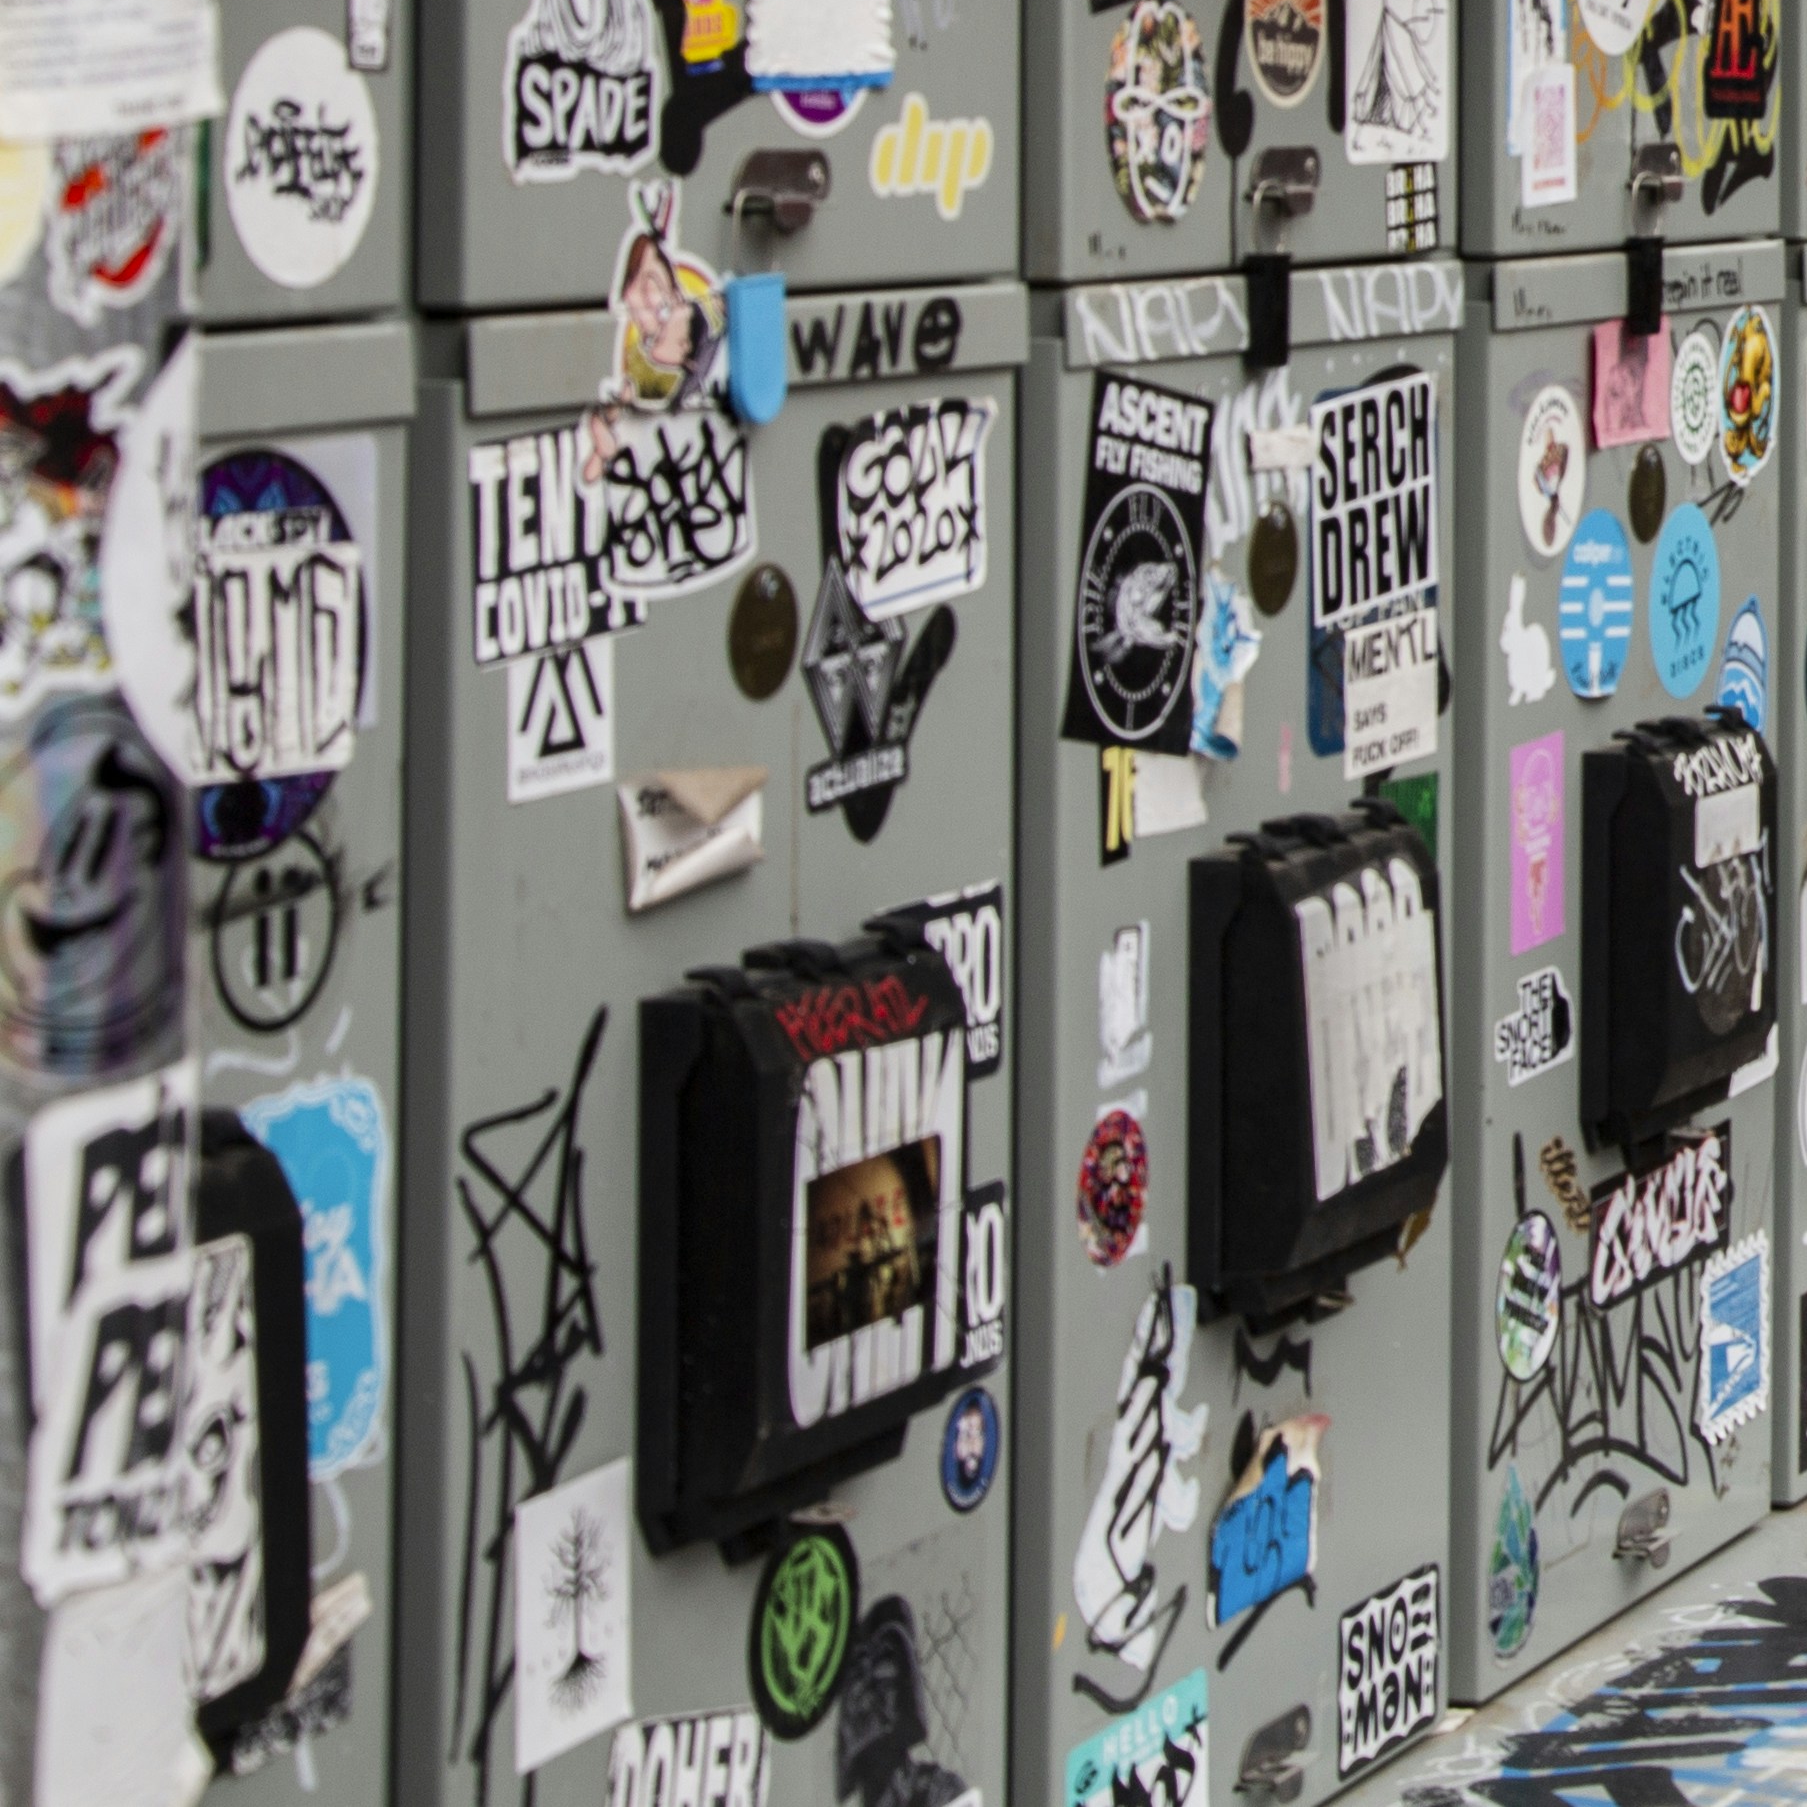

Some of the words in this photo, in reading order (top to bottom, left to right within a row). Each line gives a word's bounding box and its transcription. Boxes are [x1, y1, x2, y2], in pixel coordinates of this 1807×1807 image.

[519, 63, 651, 151] SPADE
[1095, 435, 1129, 476] FLY
[1098, 381, 1210, 456] ASCENT
[1317, 385, 1430, 511] SERCH
[1318, 482, 1432, 618] DREW
[1102, 1696, 1180, 1763] HELLO
